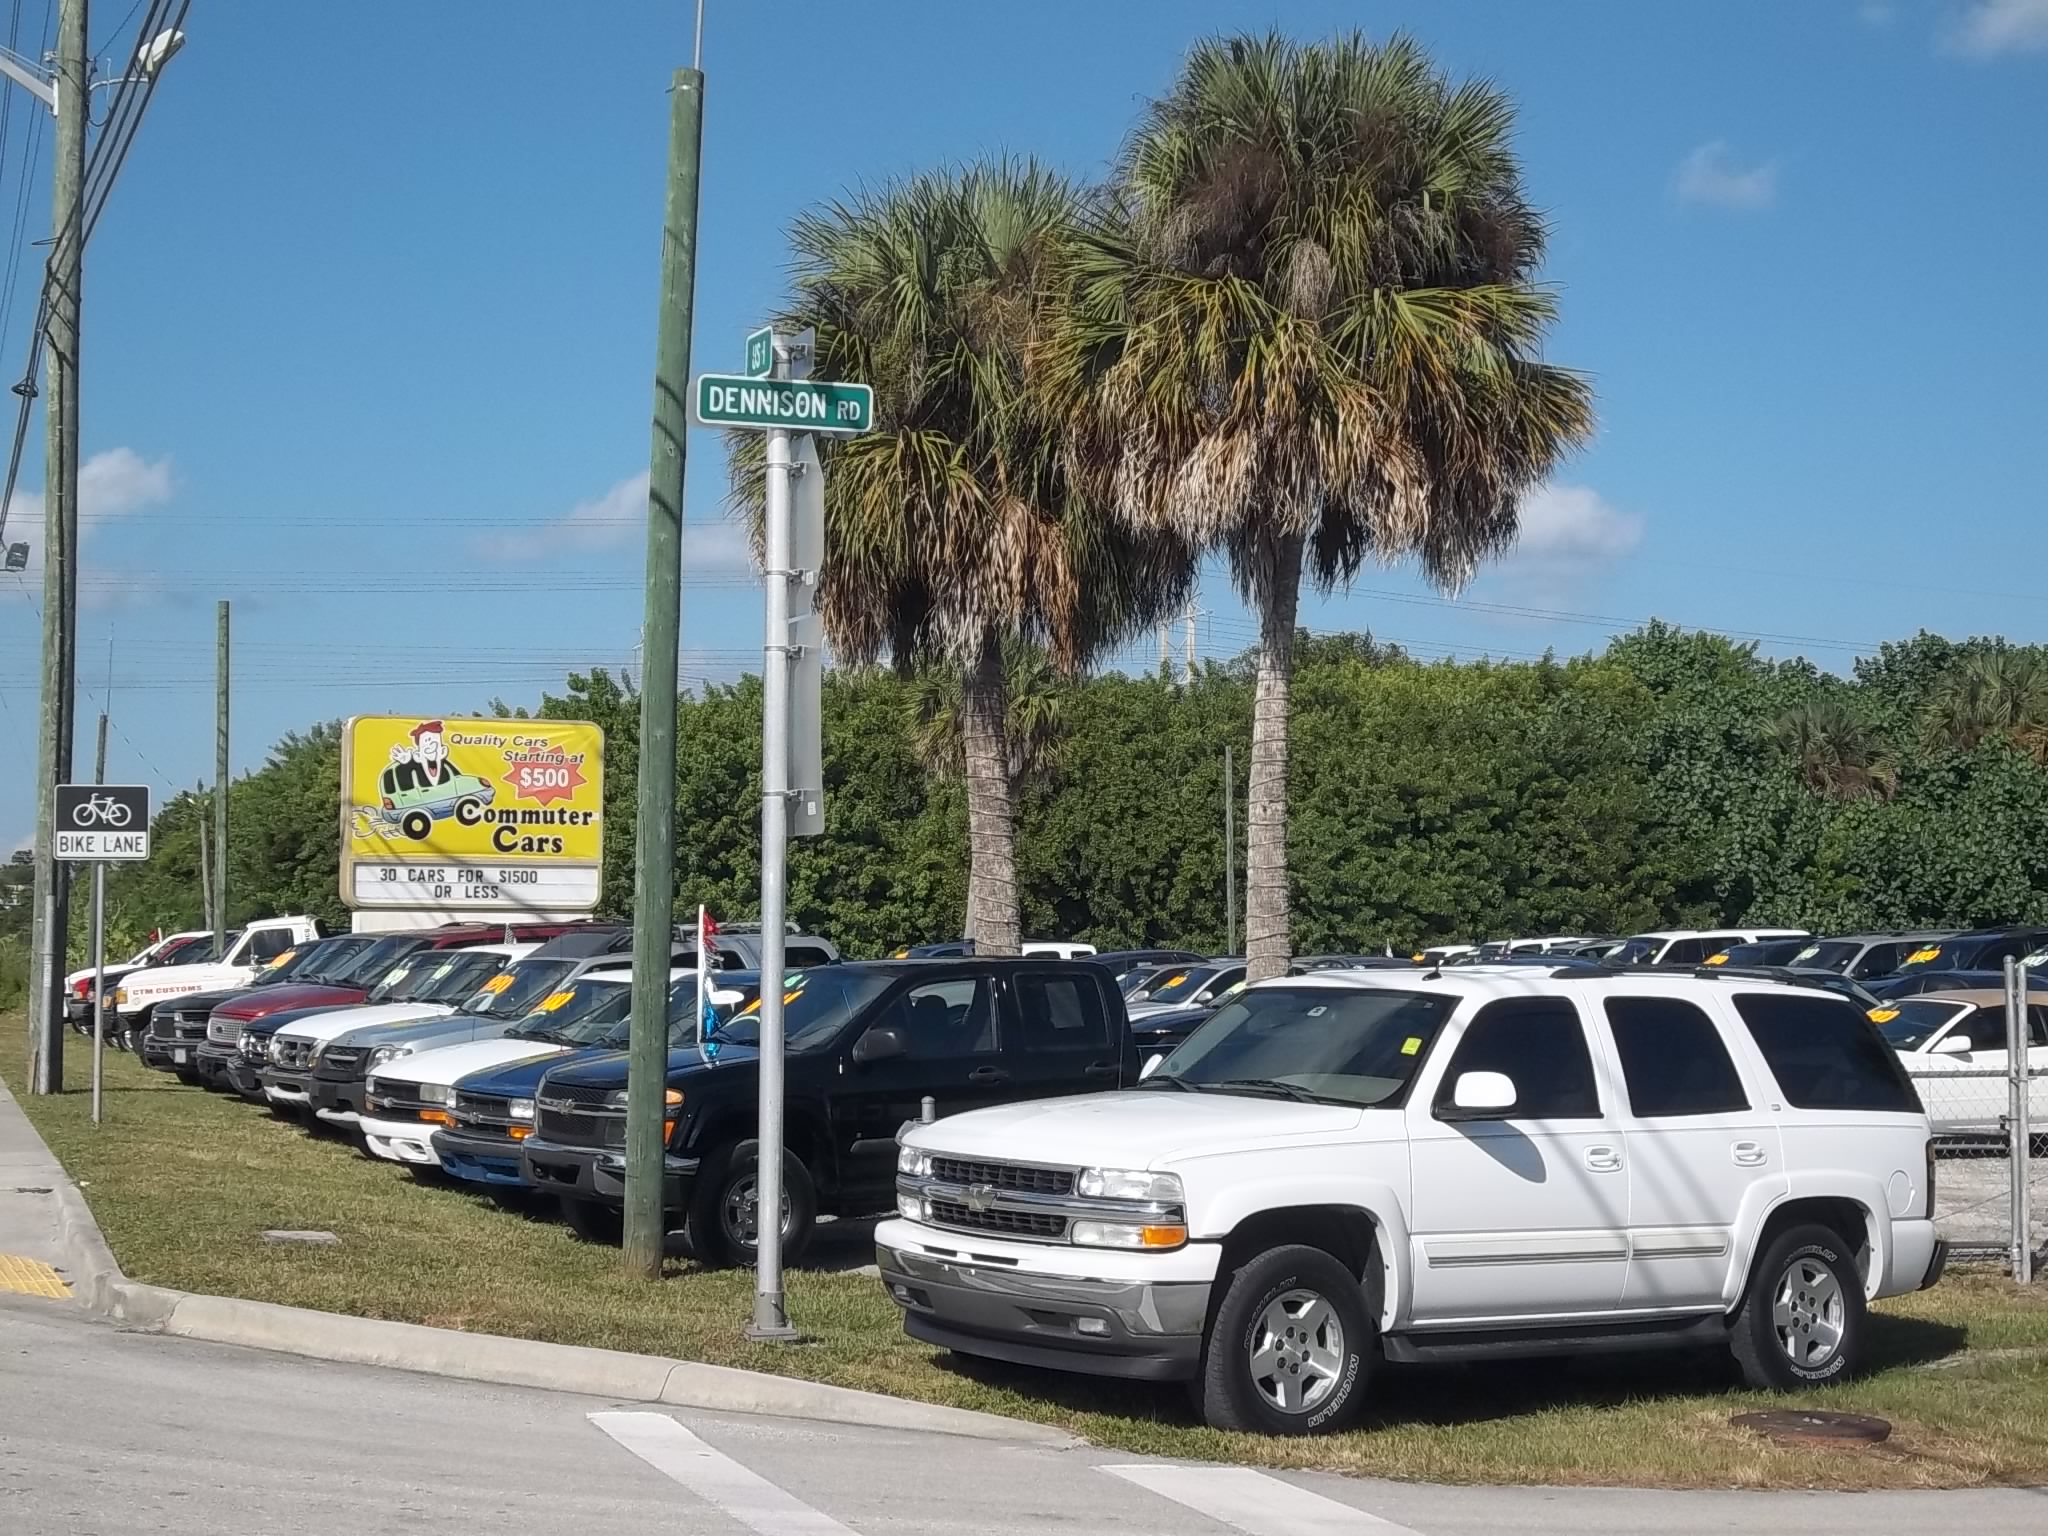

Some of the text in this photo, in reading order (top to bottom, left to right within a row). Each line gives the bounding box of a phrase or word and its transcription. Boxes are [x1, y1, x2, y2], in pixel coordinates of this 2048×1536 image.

[708, 385, 861, 421] DENNISON RD
[450, 733, 549, 748] Quality Cars
[503, 750, 585, 766] Starting at
[520, 768, 569, 788] $500
[455, 798, 593, 827] Commuter
[59, 835, 144, 853] BIKE LANE
[492, 826, 563, 853] Cars
[380, 868, 397, 882] 30
[408, 869, 445, 883] CARS
[457, 869, 483, 883] FOR
[434, 885, 499, 899] OR LESS
[156, 985, 202, 994] CUSTOMS
[1790, 1354, 1846, 1379] MICHELIN
[1307, 1353, 1360, 1428] MICHELIN
